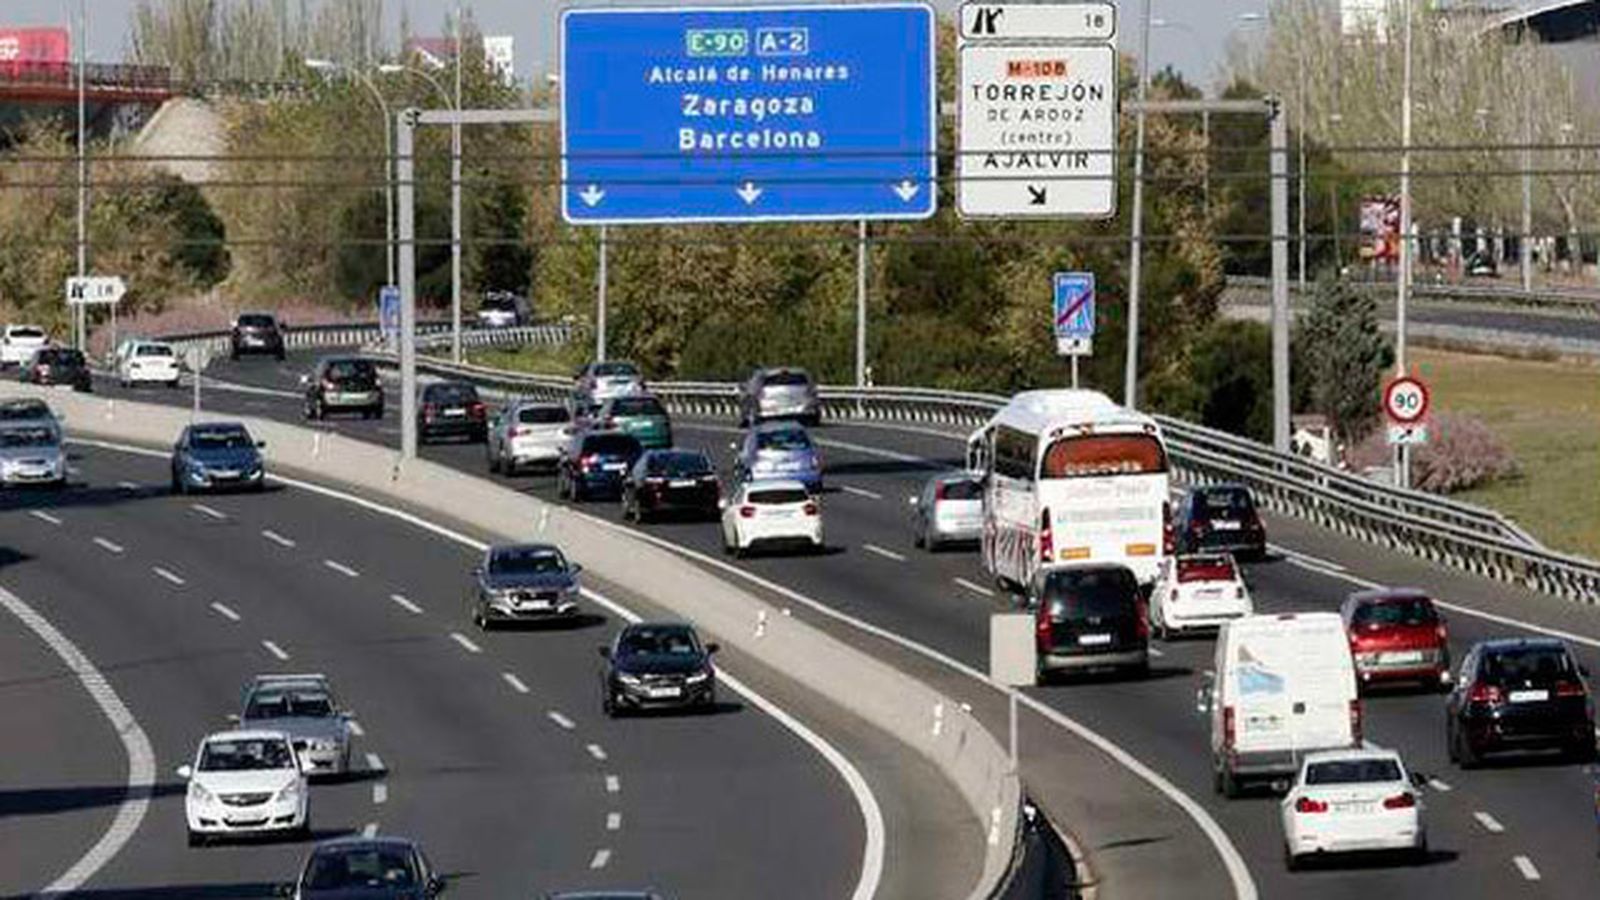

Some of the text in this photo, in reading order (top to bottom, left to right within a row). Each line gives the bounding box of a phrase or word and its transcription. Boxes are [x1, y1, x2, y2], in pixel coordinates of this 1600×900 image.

[1085, 13, 1104, 28] 18
[692, 33, 743, 51] E-90
[762, 32, 803, 51] A-2
[726, 66, 750, 82] de
[761, 64, 848, 82] Henares
[972, 79, 1102, 101] TORREJÓN
[683, 94, 814, 121] Zaragoza
[680, 128, 820, 149] Barcelona
[983, 151, 1089, 168] AJALVIR
[1394, 392, 1418, 410] 90
